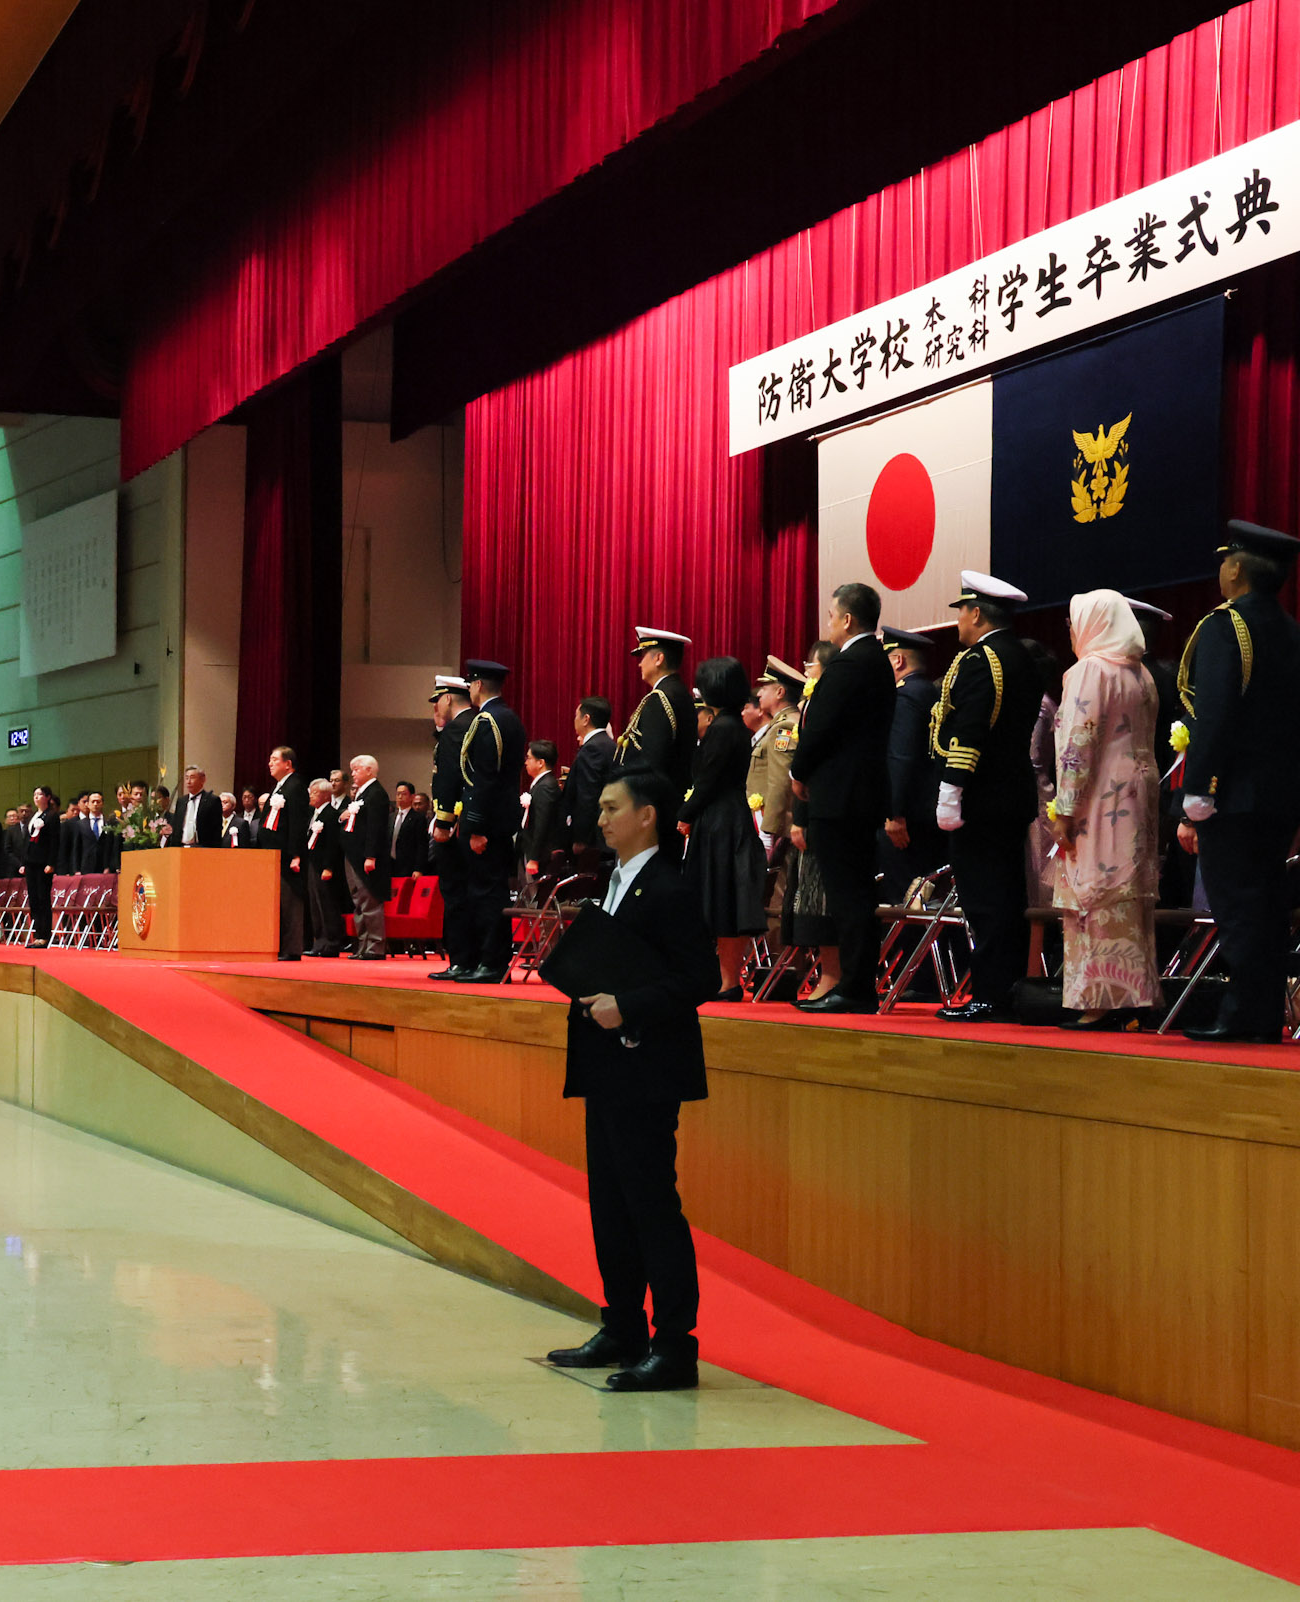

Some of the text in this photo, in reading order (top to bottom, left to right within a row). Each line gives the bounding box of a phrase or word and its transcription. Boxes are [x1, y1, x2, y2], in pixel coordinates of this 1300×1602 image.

[997, 168, 1280, 333] 学生卒業式典
[757, 318, 915, 426] 防衛大学校
[922, 314, 990, 369] 研究科
